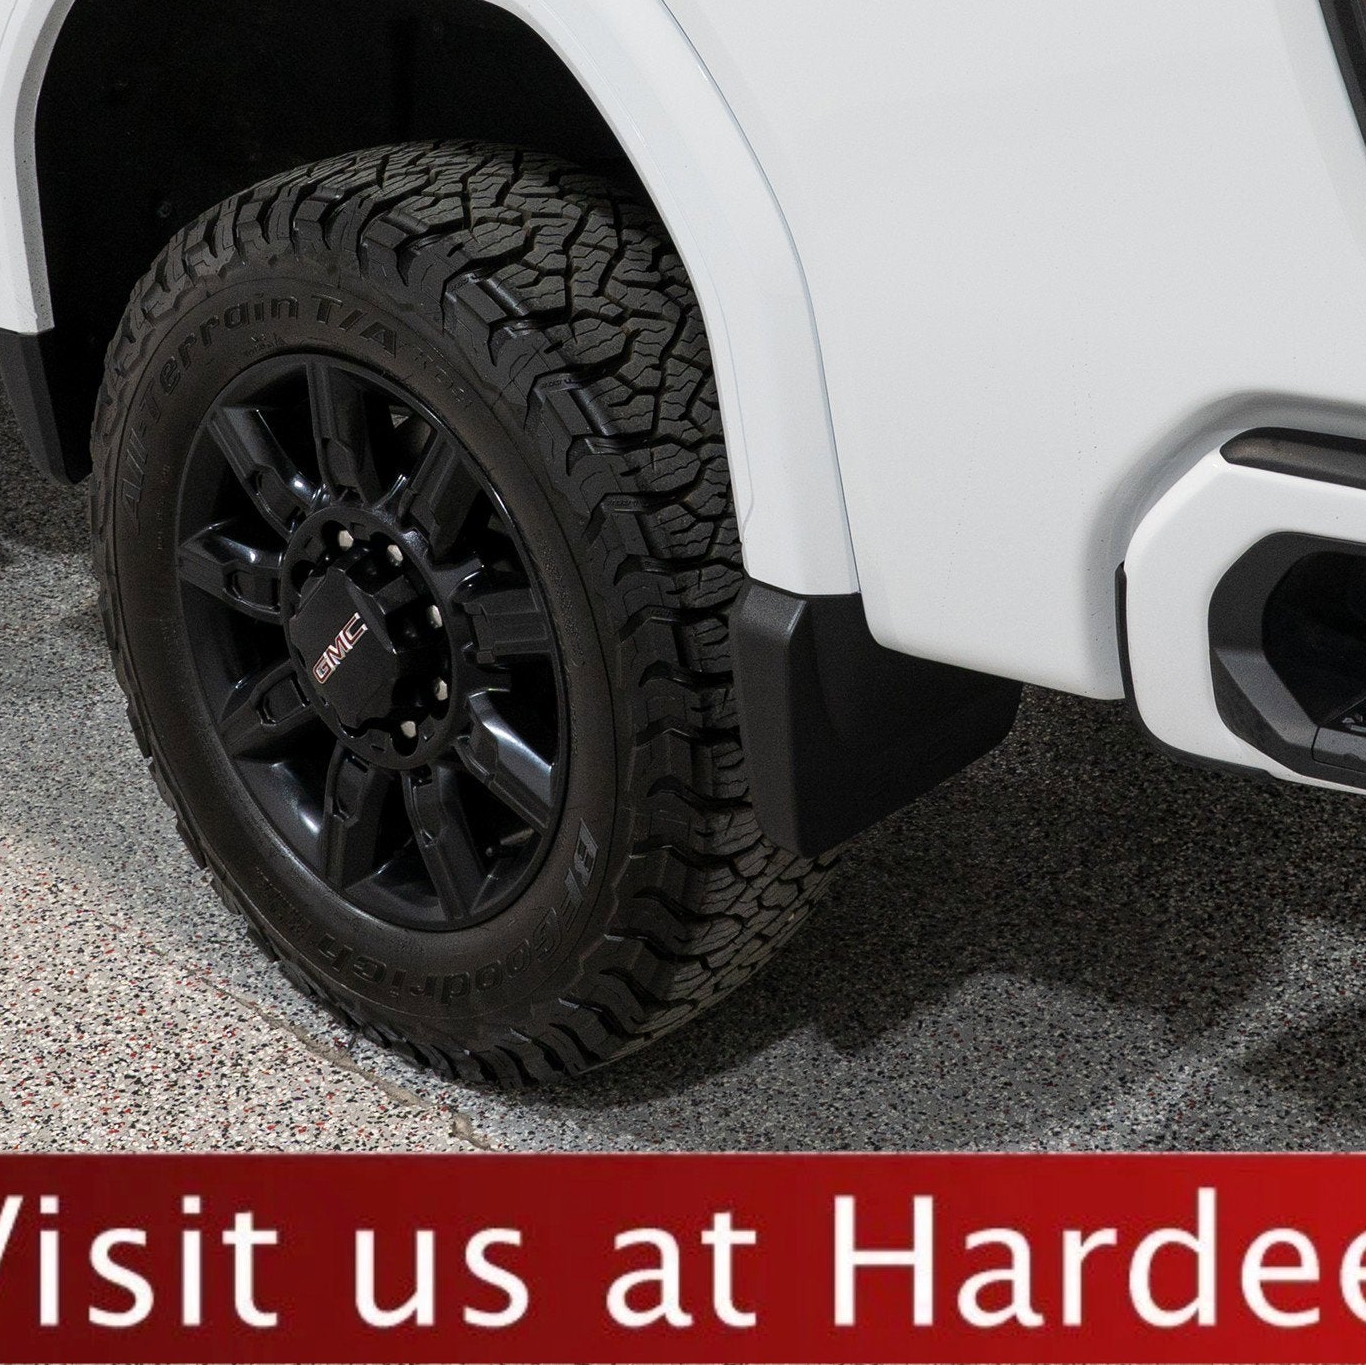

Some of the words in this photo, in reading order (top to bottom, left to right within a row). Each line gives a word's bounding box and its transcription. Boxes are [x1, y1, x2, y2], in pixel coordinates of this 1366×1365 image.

[311, 292, 399, 358] T/A
[312, 610, 368, 688] GMC
[311, 818, 599, 1004] BFGoodrich
